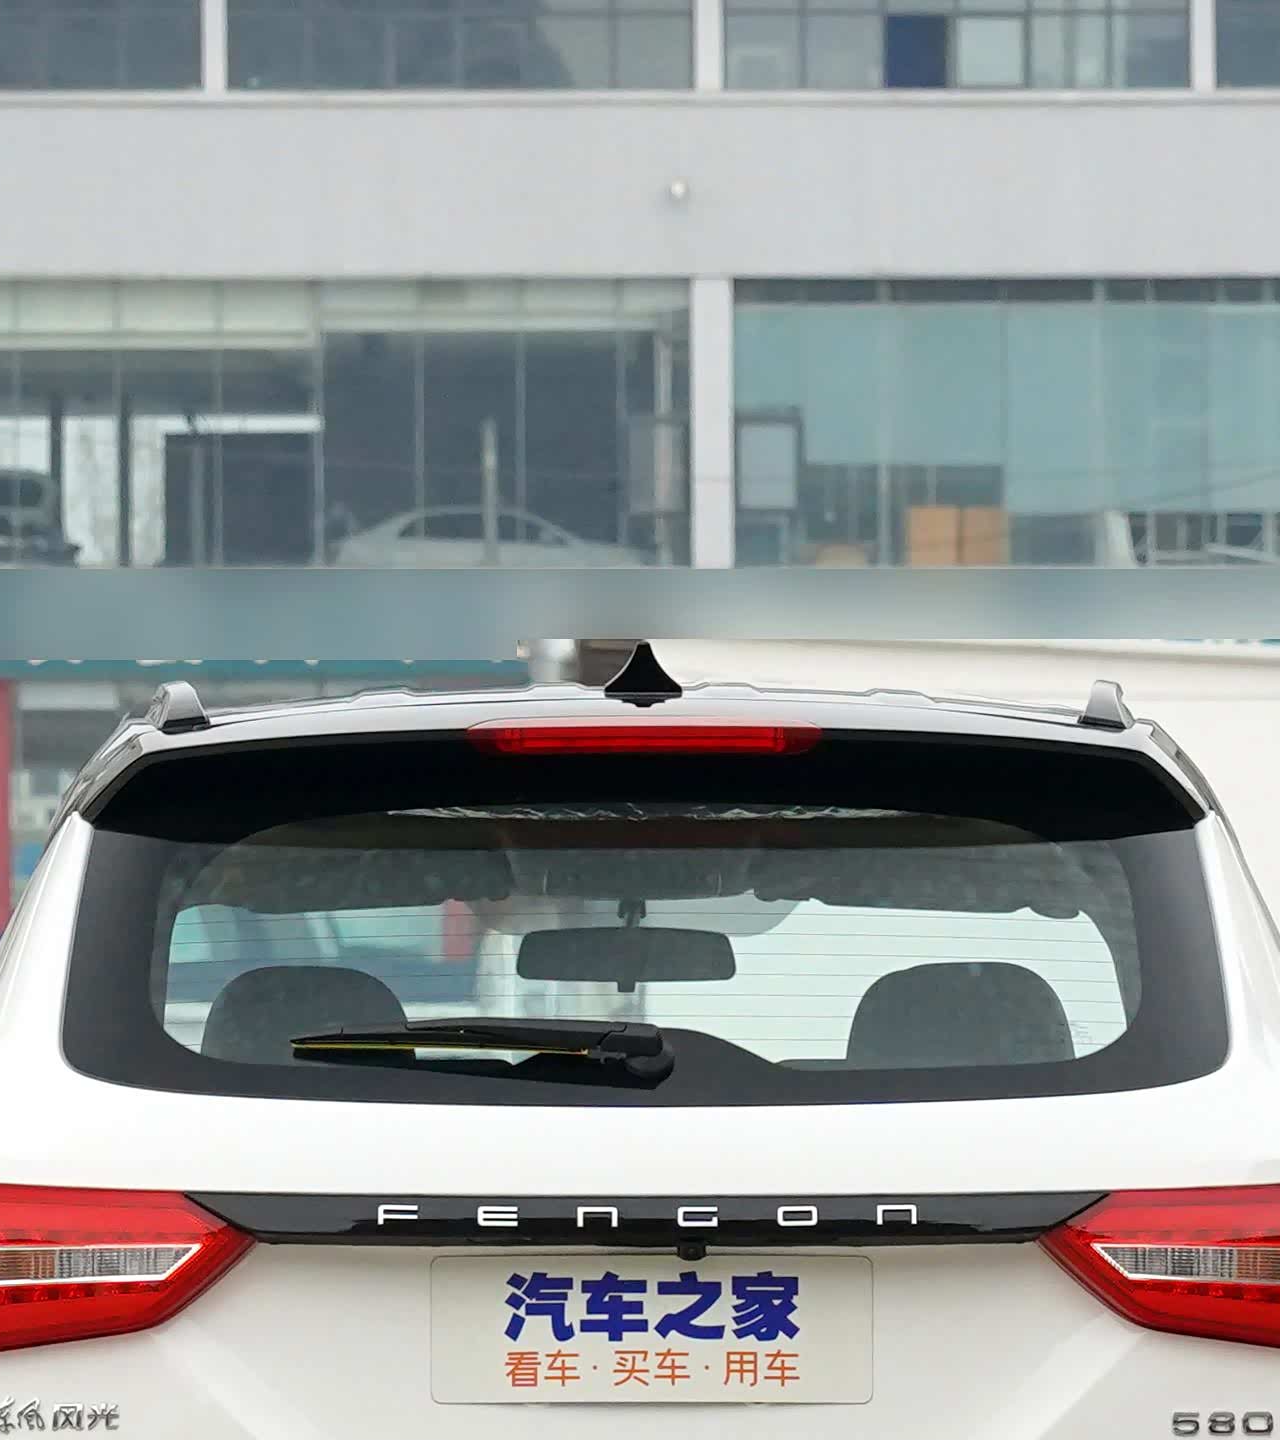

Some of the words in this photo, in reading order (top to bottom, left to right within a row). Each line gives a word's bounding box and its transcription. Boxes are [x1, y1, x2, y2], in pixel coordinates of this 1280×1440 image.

[376, 1203, 919, 1229] FENGON
[503, 1270, 801, 1343] 汽车之家
[1171, 1410, 1275, 1437] 580
